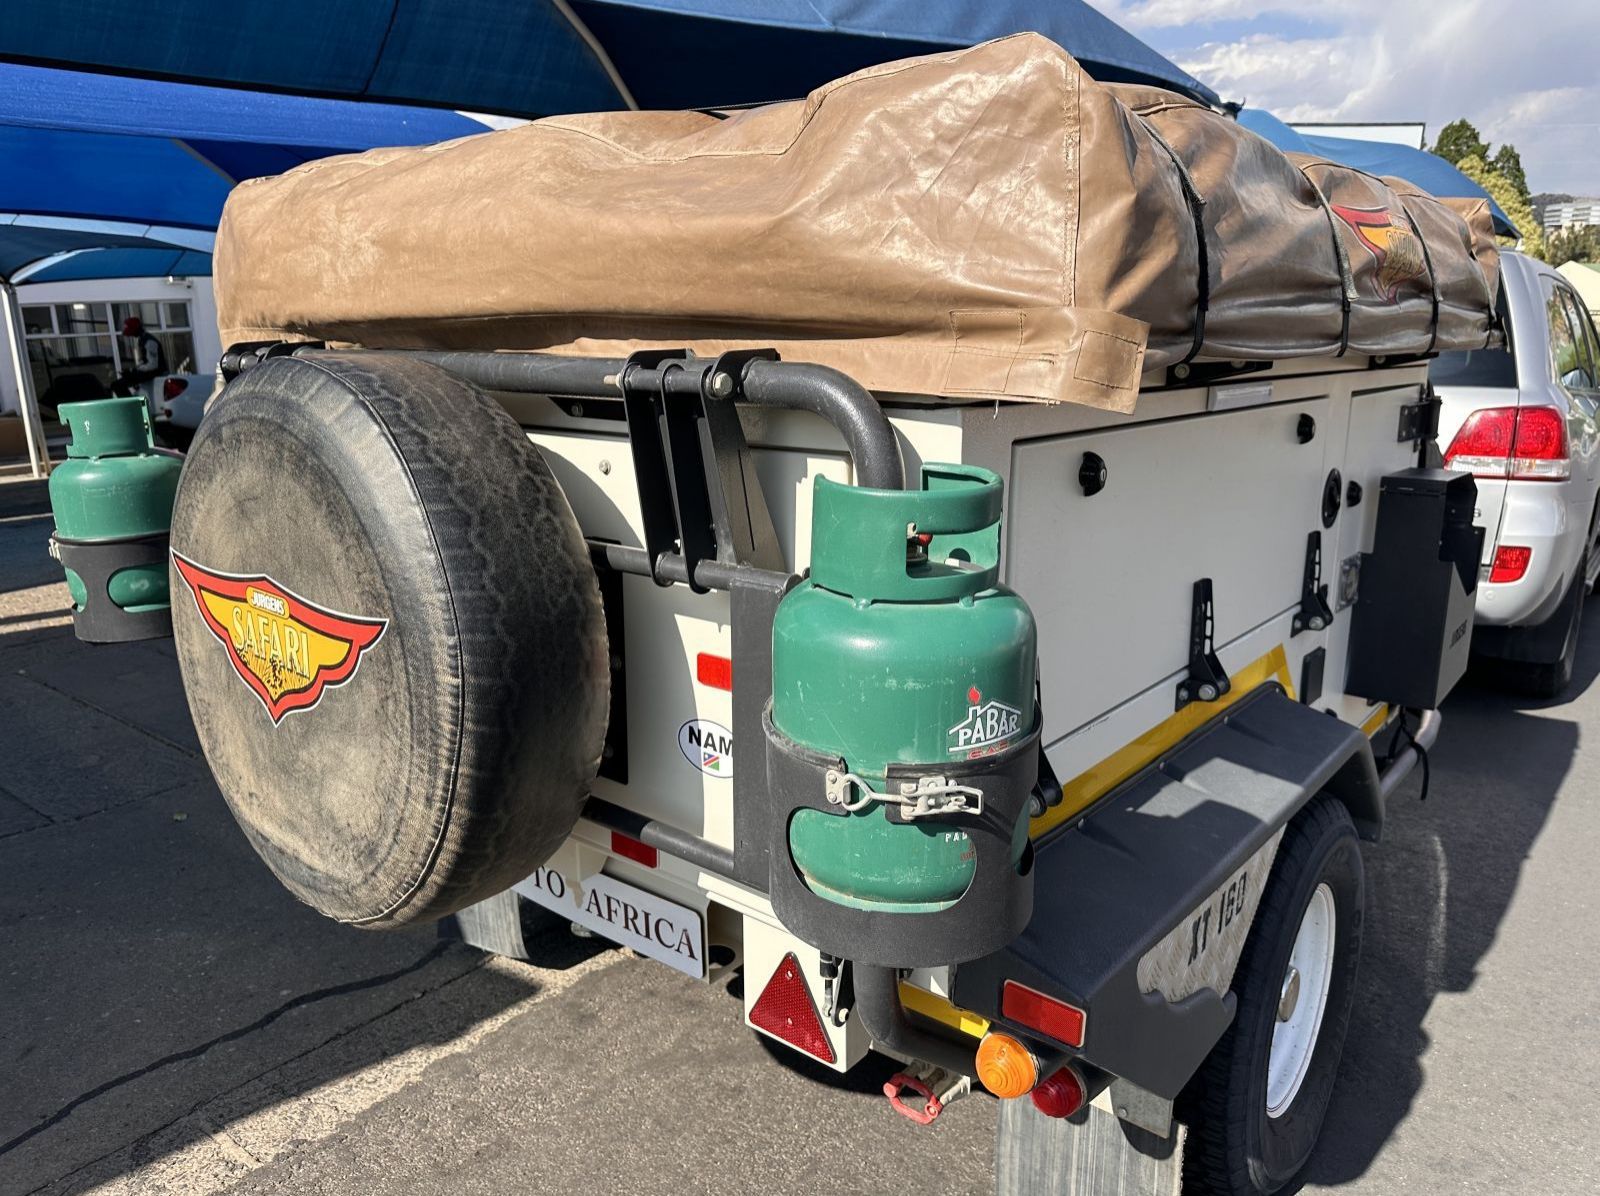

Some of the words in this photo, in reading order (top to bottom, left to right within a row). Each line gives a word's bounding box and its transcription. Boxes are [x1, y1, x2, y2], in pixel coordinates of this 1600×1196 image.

[232, 606, 310, 679] SAFARI
[688, 725, 733, 758] NAM
[958, 708, 1018, 747] PABAR
[585, 888, 698, 961] AFRICA
